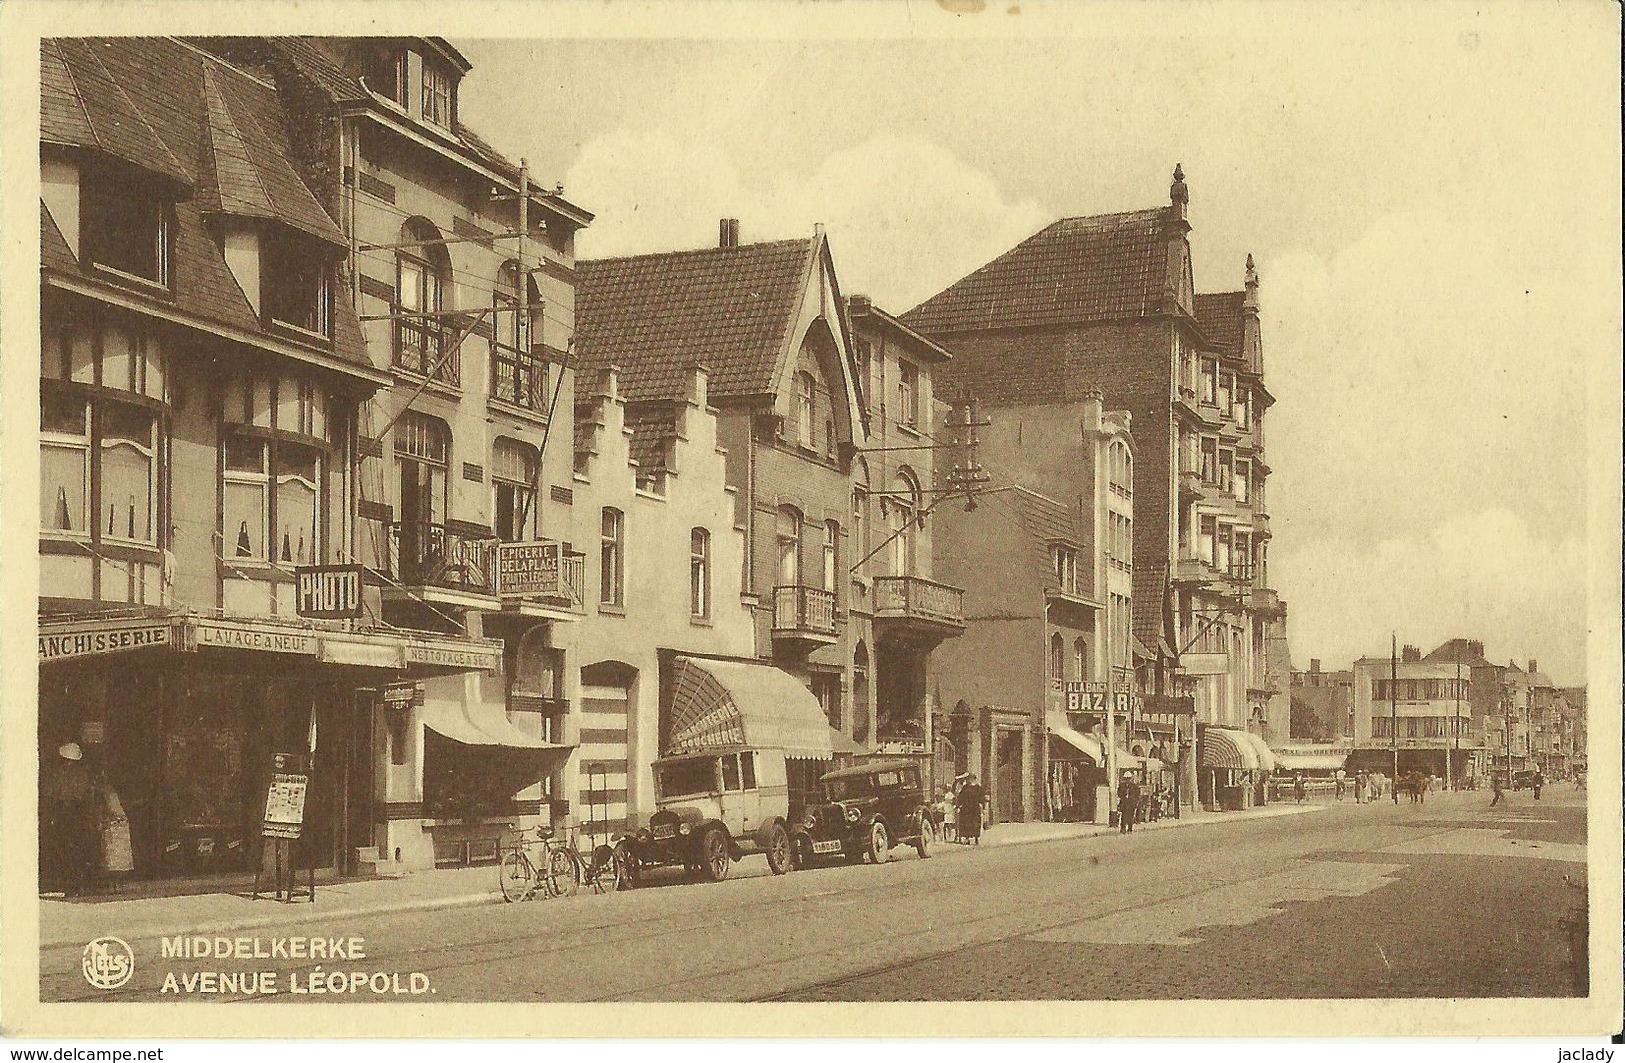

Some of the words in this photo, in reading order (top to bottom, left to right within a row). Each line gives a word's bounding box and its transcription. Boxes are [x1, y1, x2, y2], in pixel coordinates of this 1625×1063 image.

[501, 547, 550, 560] EPICERIE
[501, 560, 515, 572] DE
[515, 560, 528, 572] LA
[528, 558, 557, 571] PLACE
[300, 571, 359, 611] PHOTO
[39, 630, 165, 658] ANCHISSERIE
[204, 628, 261, 647] LAVAGE
[274, 637, 308, 651] NEUF
[411, 649, 465, 665] NETTOYAGE
[473, 654, 488, 666] SEC
[681, 727, 743, 748] BOUCHERIE
